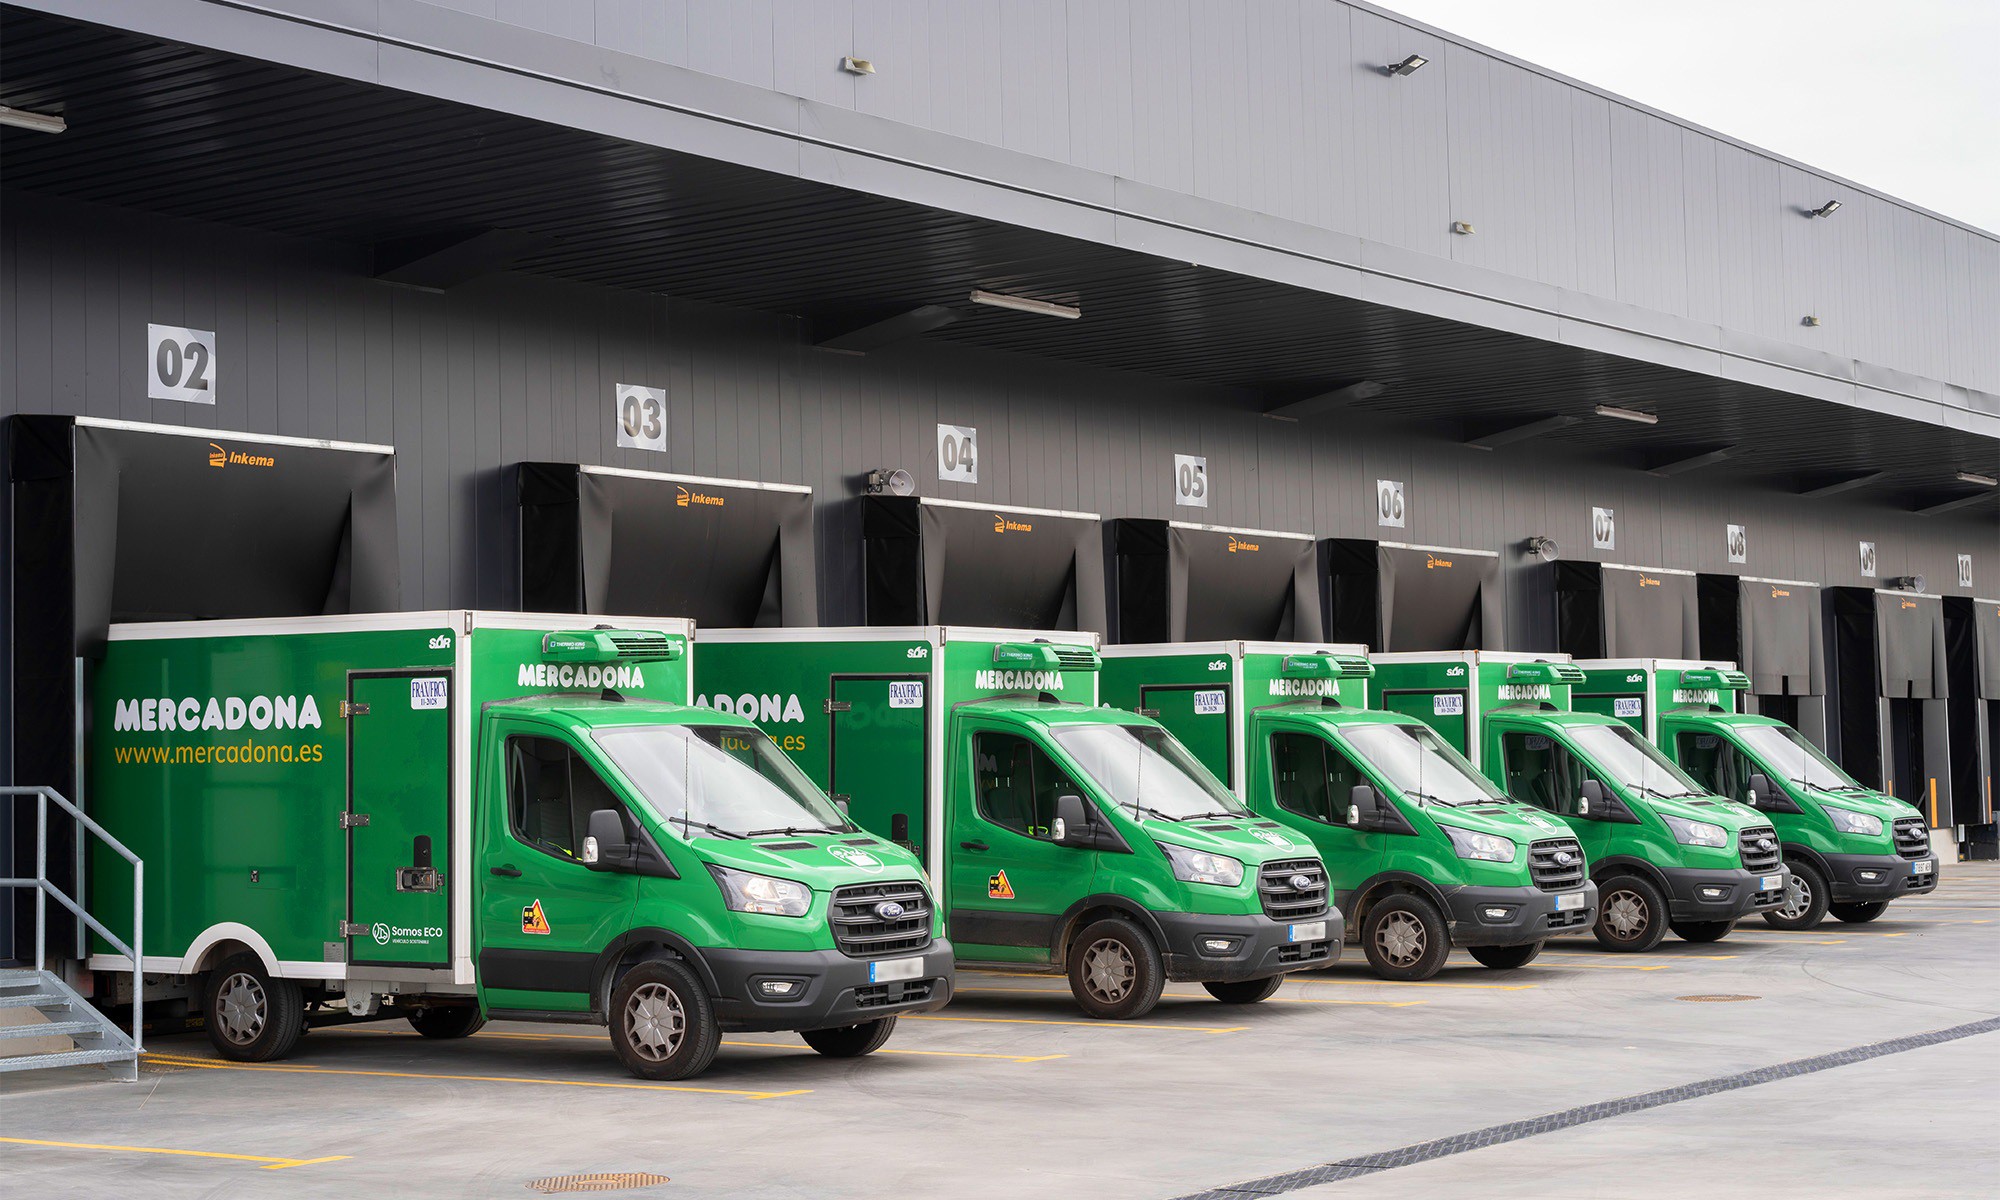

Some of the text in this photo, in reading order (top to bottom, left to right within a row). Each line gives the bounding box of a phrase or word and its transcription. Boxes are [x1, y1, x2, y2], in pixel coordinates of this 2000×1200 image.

[157, 338, 209, 391] 02
[623, 395, 662, 440] 03
[229, 451, 275, 467] Inkema
[942, 434, 974, 473] 04
[1179, 463, 1205, 498] 05
[691, 493, 725, 506] Inkema
[1381, 488, 1402, 520] 06
[1006, 521, 1032, 532] Inkema
[1595, 514, 1612, 542] 07
[1730, 531, 1744, 557] 08
[1862, 548, 1874, 571] 09
[1960, 559, 1971, 583] 10
[518, 663, 645, 689] MERCADONA
[975, 669, 1064, 690] MERCADONA
[1269, 678, 1340, 696] MERCADONA
[411, 680, 447, 698] FRAX/FRCX
[1497, 684, 1551, 700] MERCADONA
[1672, 688, 1719, 704] MERCADONA
[114, 694, 322, 732] MERCADONA
[114, 738, 323, 763] www.mercadona.es
[392, 926, 443, 937] Somos ECO
